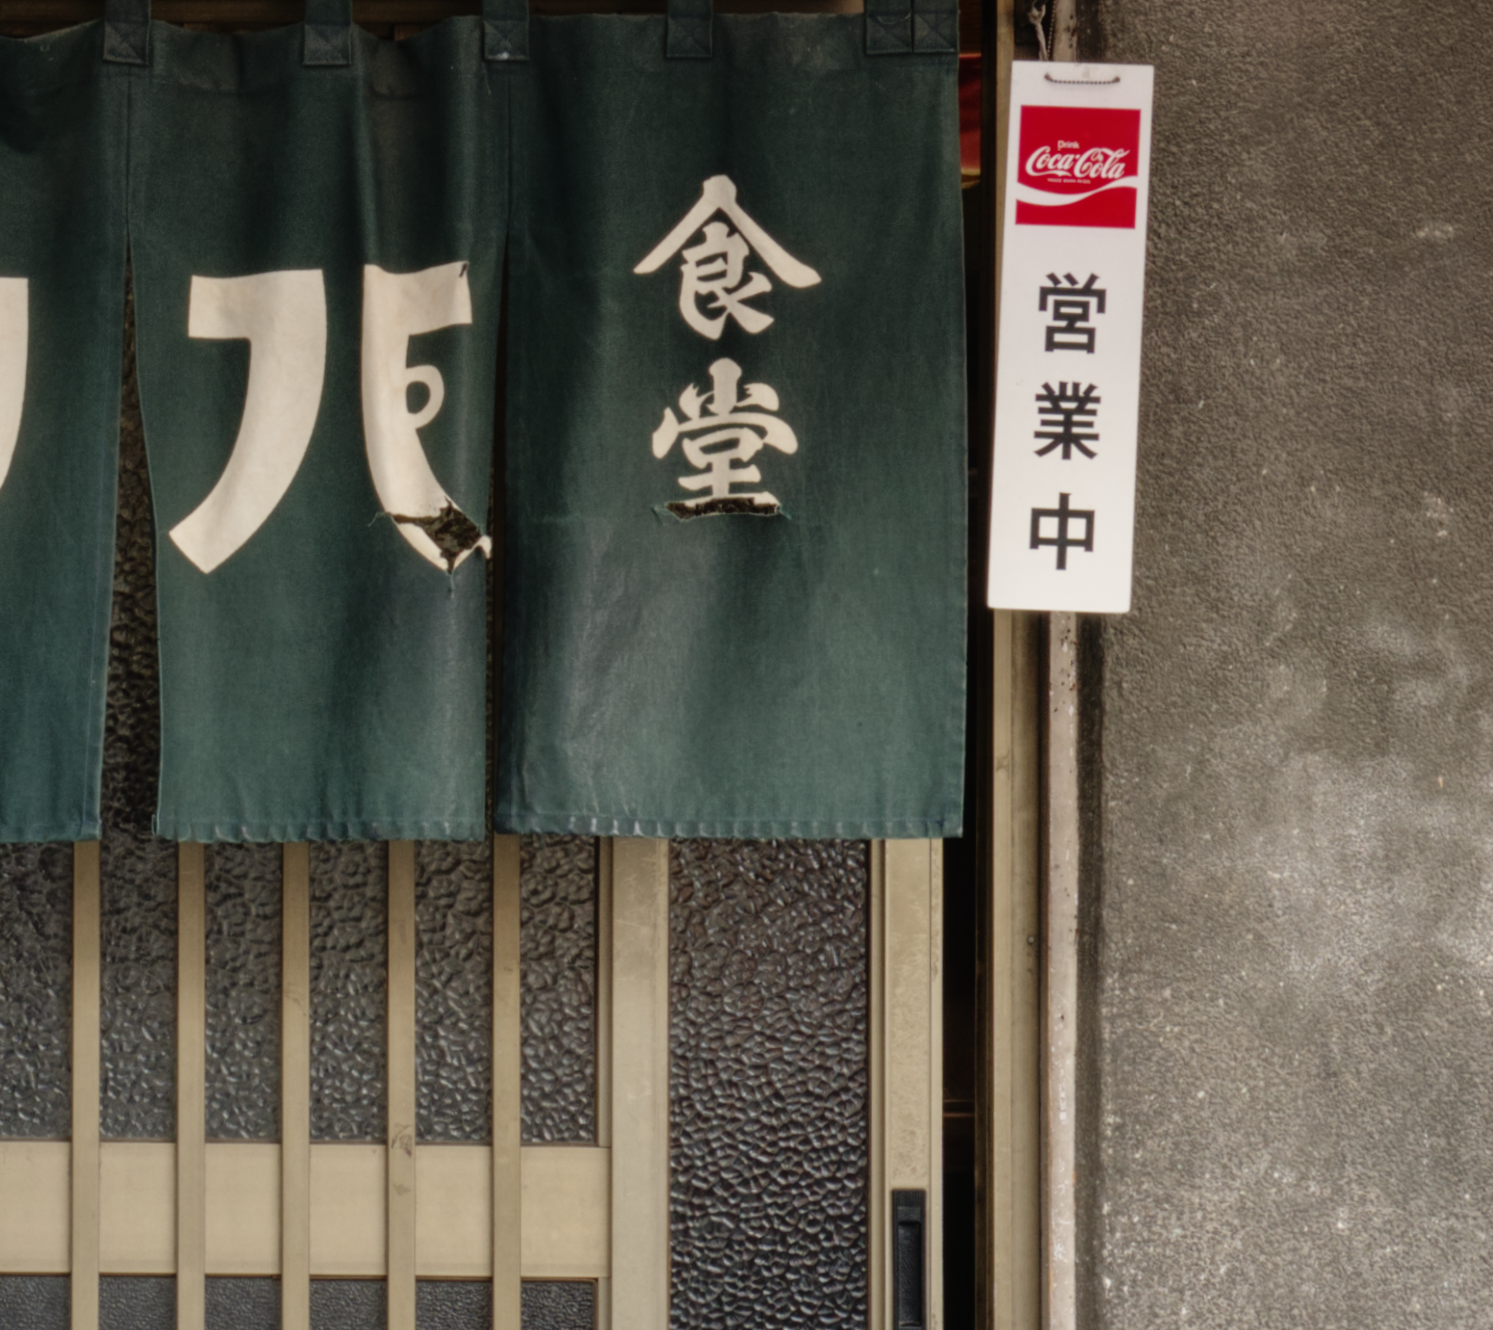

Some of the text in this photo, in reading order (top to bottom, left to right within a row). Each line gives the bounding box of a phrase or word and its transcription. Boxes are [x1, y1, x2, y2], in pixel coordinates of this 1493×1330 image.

[1025, 145, 1131, 179] Coca-Cola
[1057, 140, 1080, 151] Drink
[633, 173, 822, 521] 食堂
[1029, 272, 1107, 571] 営業中
